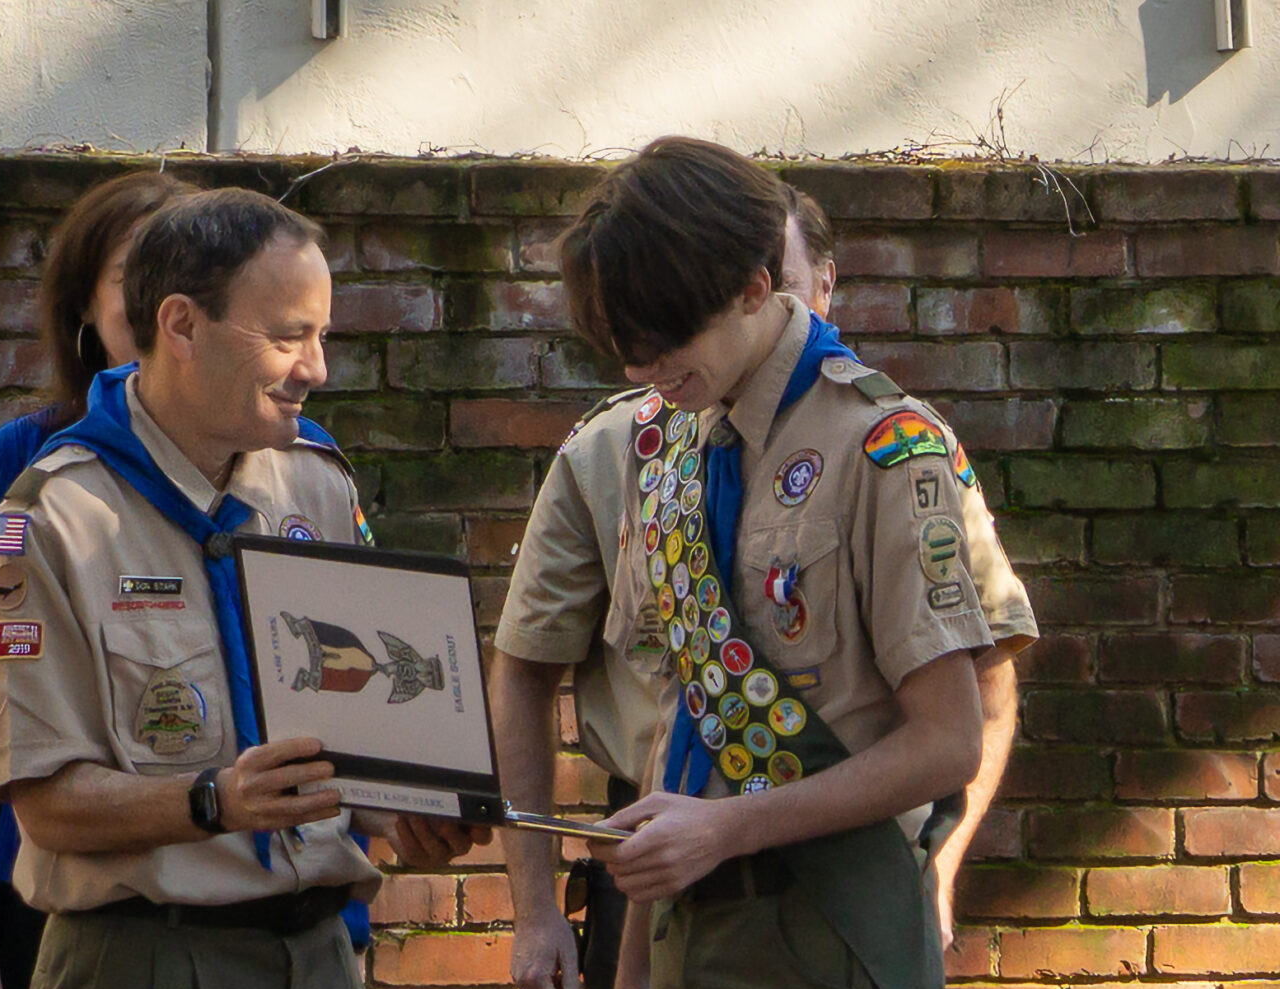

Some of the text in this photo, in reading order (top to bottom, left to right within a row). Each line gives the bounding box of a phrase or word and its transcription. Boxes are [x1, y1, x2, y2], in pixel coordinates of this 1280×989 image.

[915, 477, 940, 509] 57
[446, 634, 464, 714] EAGLE SCOUT
